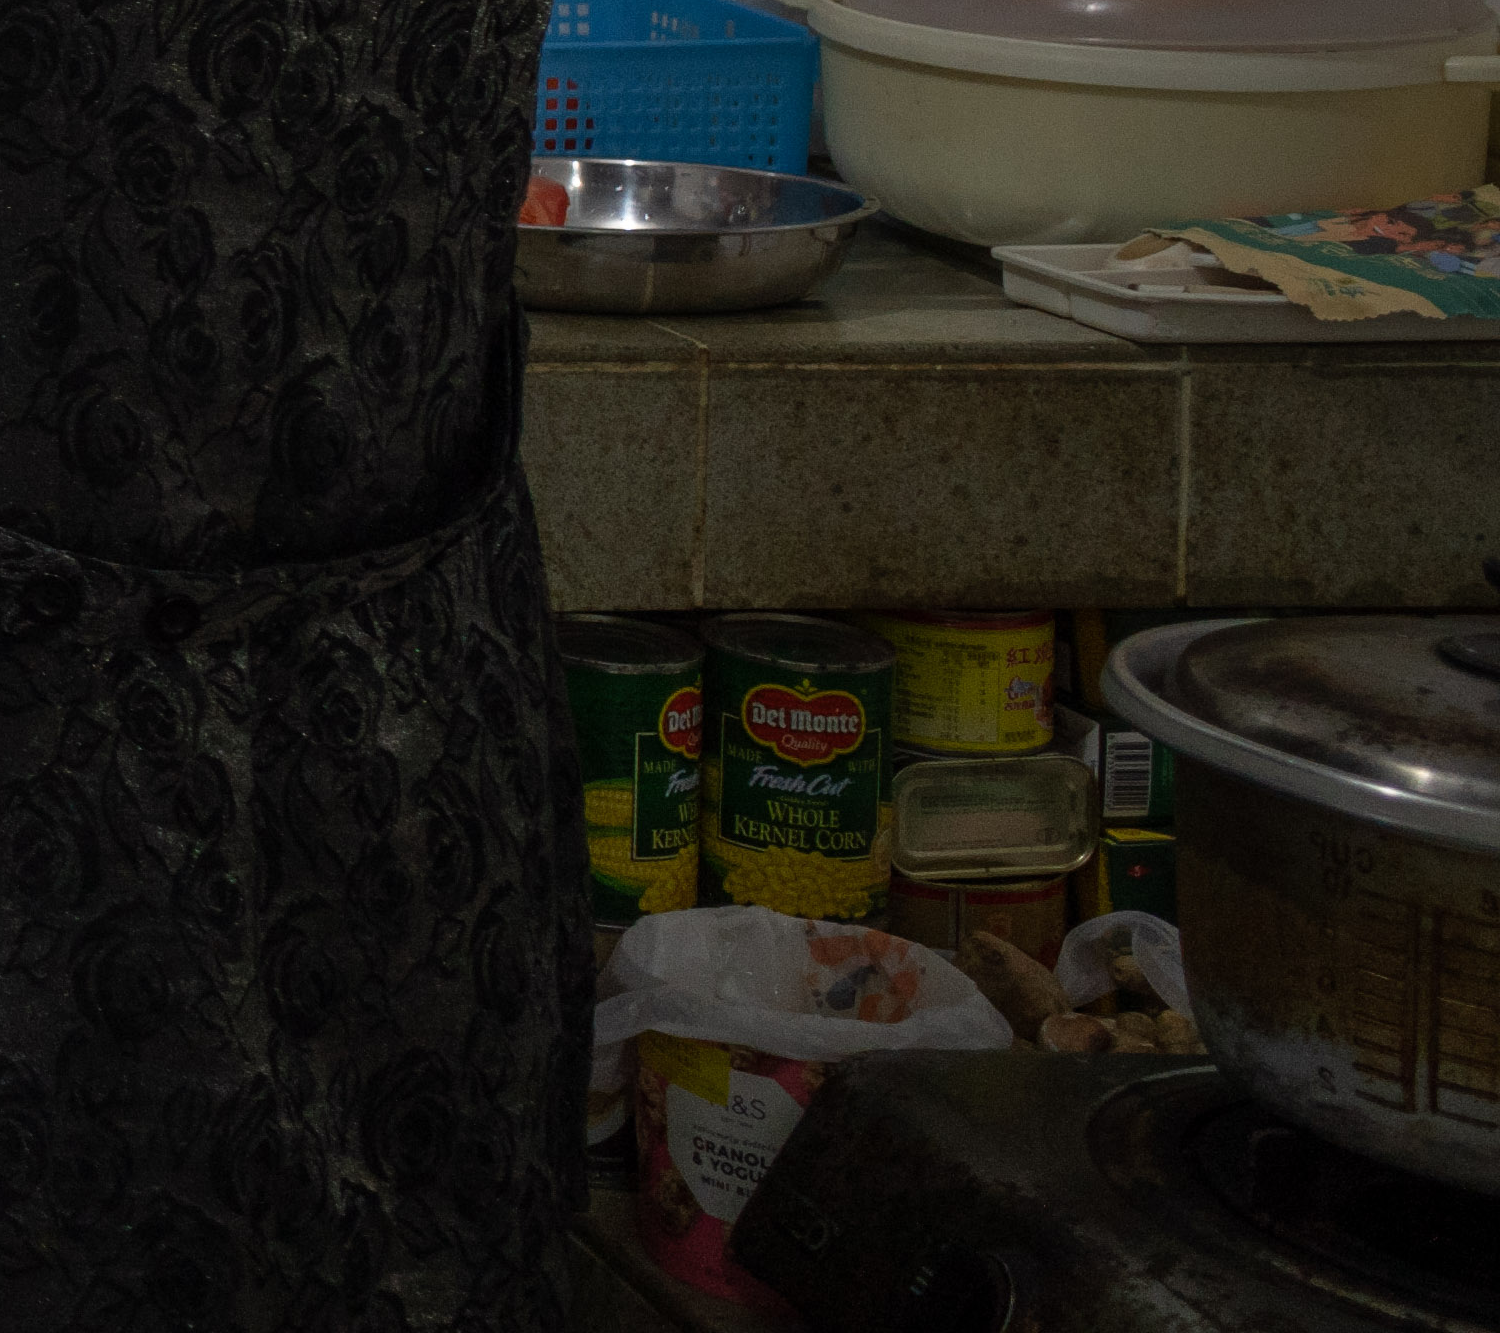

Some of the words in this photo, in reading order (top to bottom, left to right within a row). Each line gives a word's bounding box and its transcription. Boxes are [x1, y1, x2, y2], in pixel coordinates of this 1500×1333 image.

[667, 709, 690, 733] Del
[751, 701, 786, 727] Del
[789, 704, 860, 734] Monte
[726, 743, 764, 763] MADE
[781, 734, 829, 755] Quality
[643, 759, 678, 774] MADE
[749, 764, 804, 793] Fresh
[805, 773, 855, 798] Cut
[766, 799, 841, 829] WHOLE
[734, 814, 811, 848] KERNEL
[815, 829, 868, 851] CORN
[724, 1094, 767, 1122] &S
[701, 1175, 731, 1193] MINI
